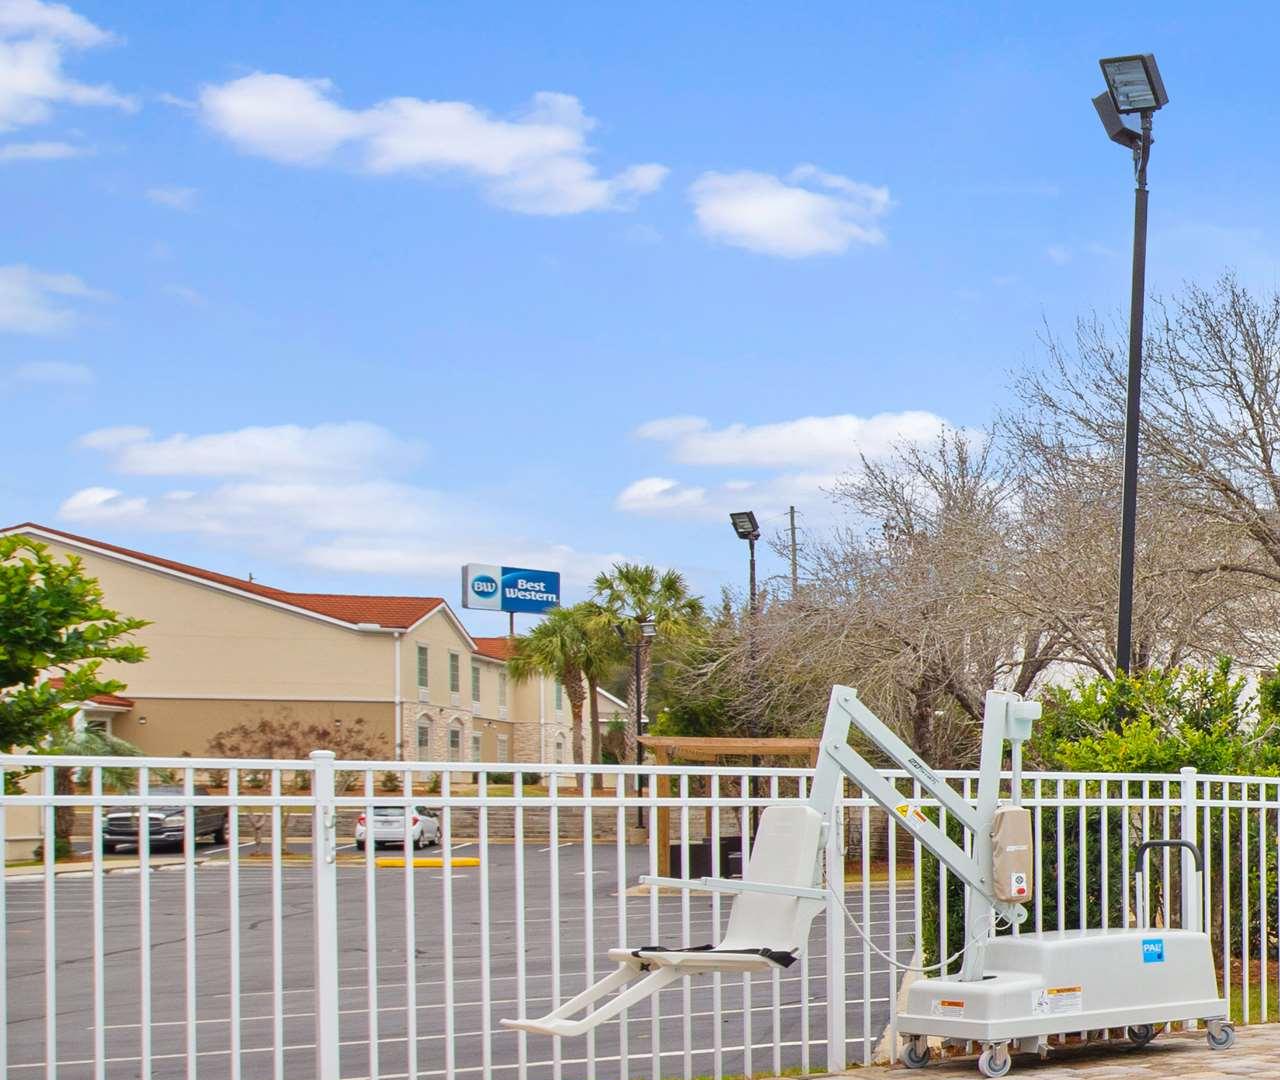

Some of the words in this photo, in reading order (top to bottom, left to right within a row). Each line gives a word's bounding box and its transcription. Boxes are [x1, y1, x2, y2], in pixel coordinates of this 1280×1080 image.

[474, 582, 496, 592] BW
[518, 579, 546, 591] Best
[505, 587, 557, 602] Western
